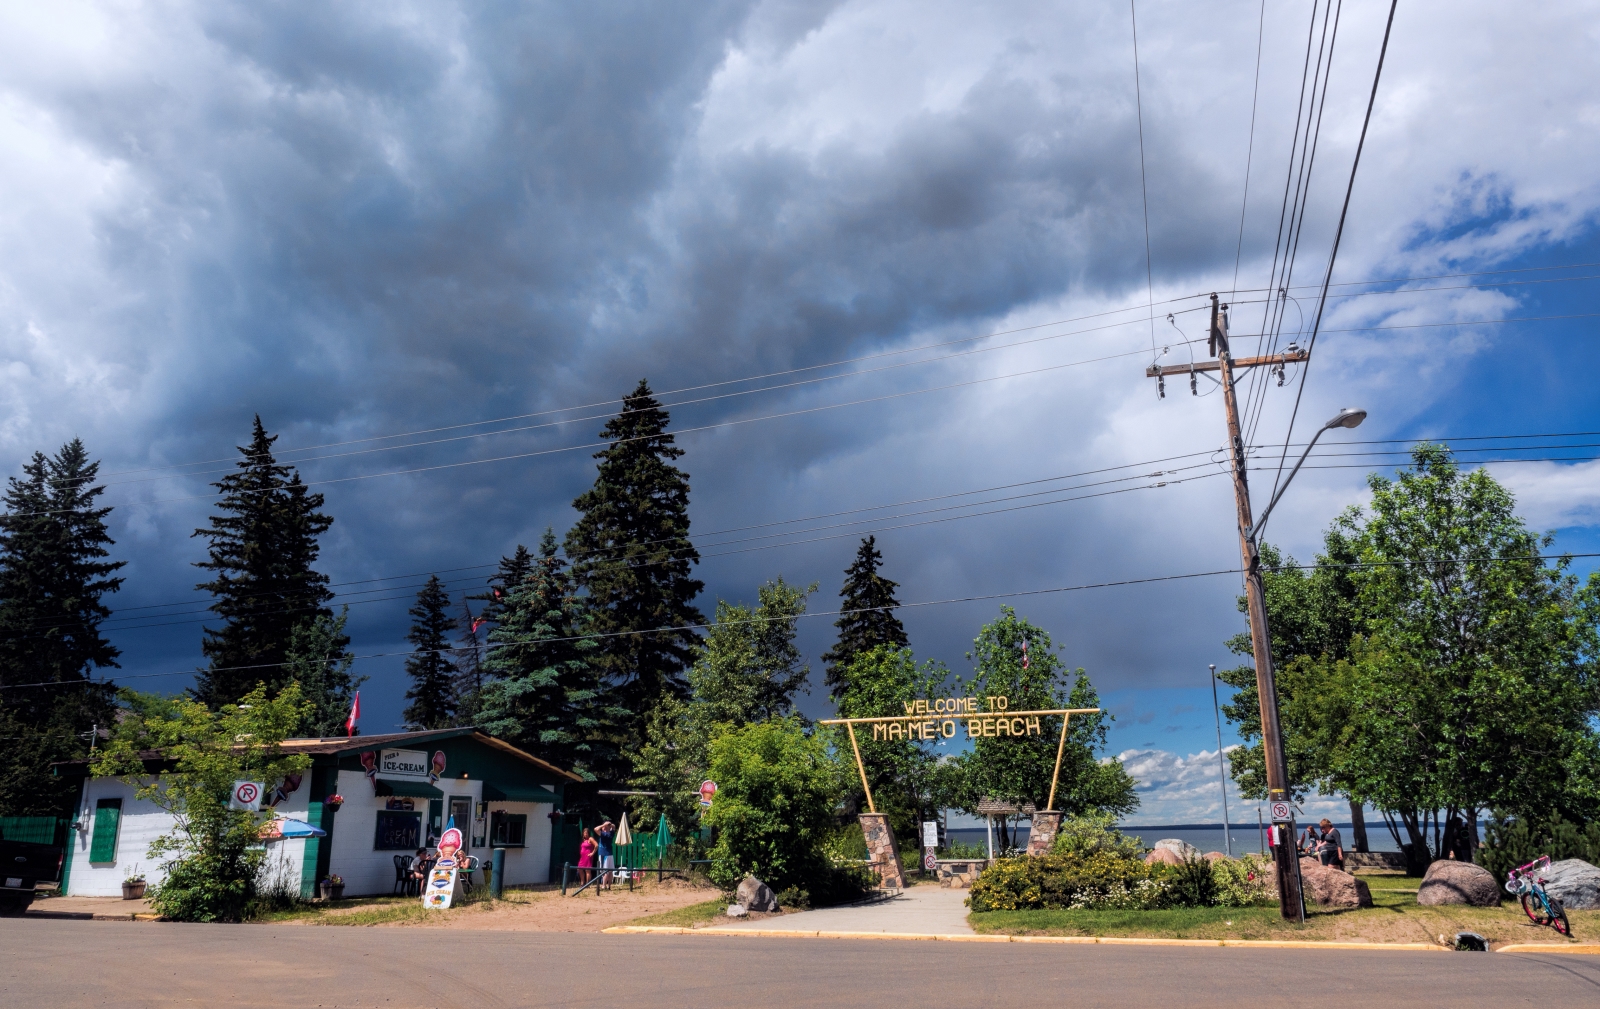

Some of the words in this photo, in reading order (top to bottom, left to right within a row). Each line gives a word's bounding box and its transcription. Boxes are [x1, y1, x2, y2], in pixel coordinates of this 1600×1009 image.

[904, 696, 978, 714] WELCOME
[986, 695, 1008, 711] TO
[968, 716, 1041, 738] BEACH
[384, 753, 396, 761] PIER
[383, 761, 425, 773] ICE-CREAM
